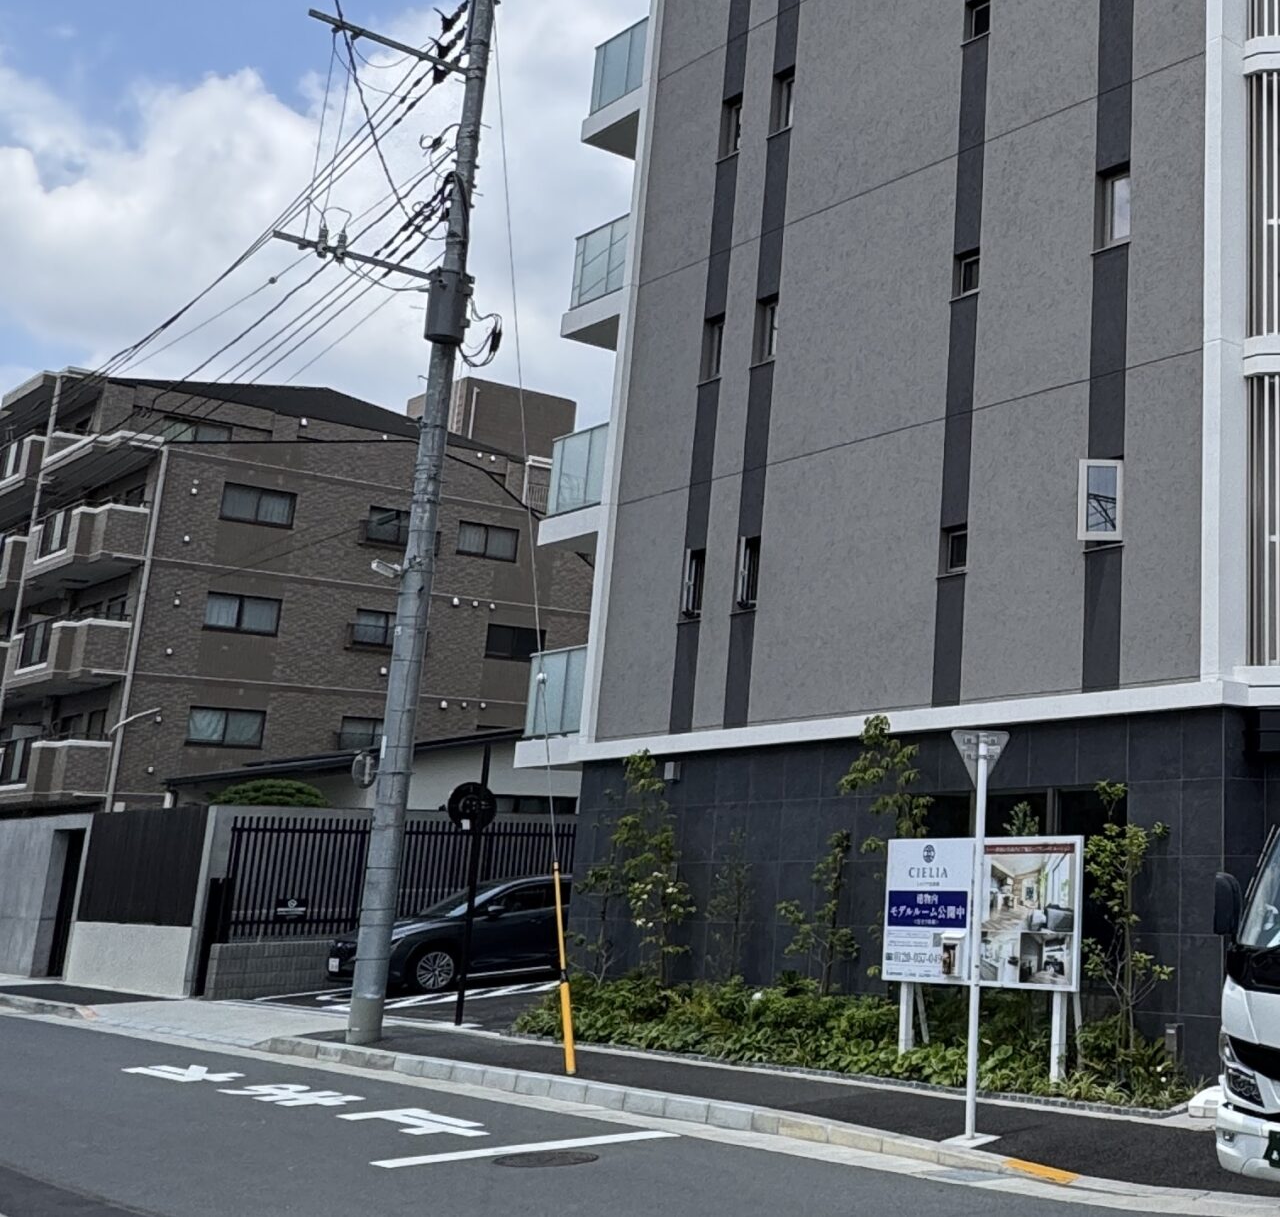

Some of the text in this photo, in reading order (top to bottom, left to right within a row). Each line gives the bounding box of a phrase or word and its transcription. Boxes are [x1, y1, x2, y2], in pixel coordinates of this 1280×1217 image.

[908, 866, 949, 879] CIELIA
[890, 905, 965, 919] モデルルーム公開中
